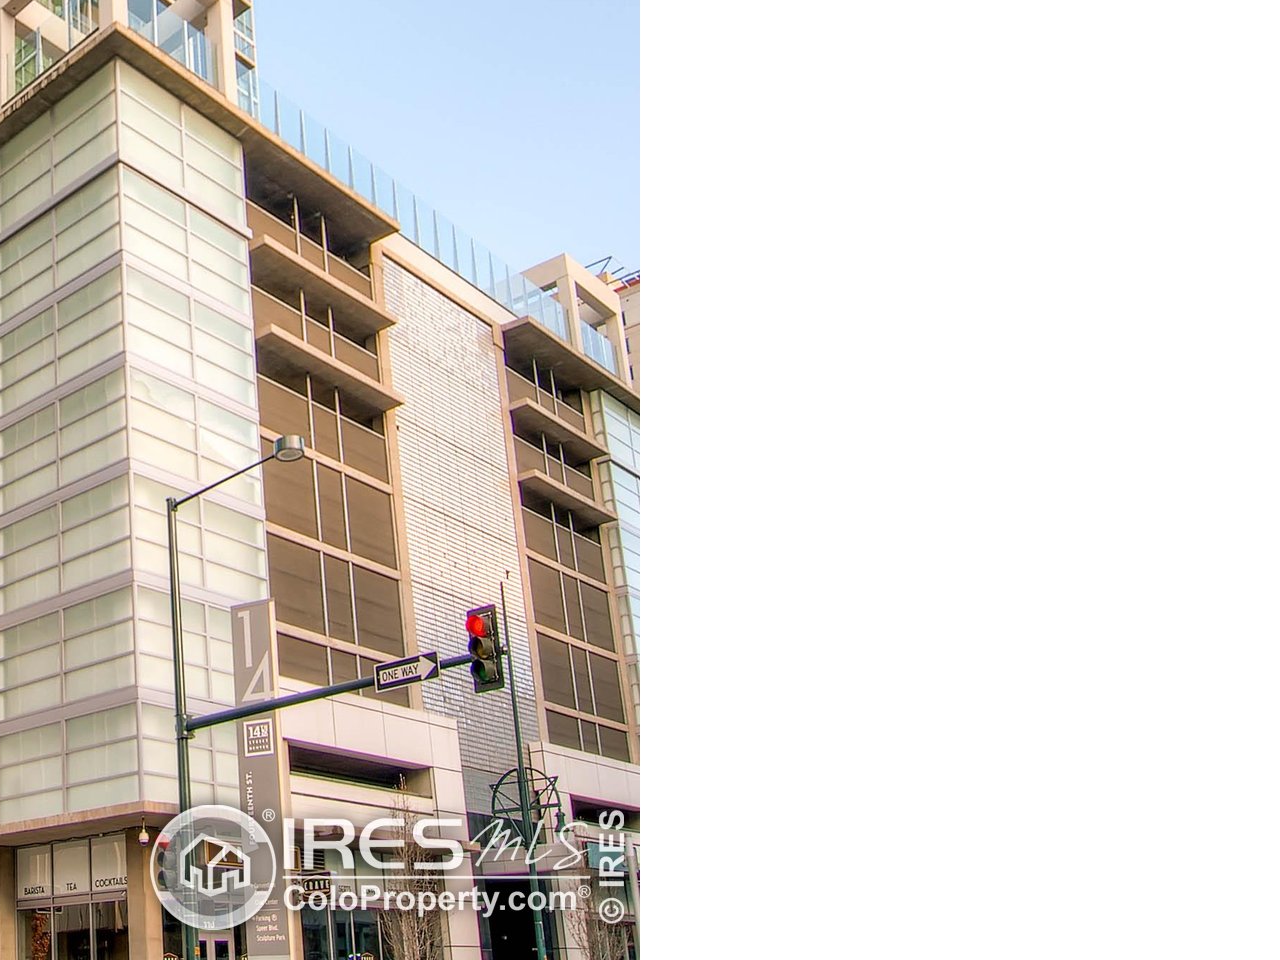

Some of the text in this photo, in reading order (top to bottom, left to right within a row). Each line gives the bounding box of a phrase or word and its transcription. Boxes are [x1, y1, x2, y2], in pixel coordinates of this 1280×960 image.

[381, 664, 419, 682] ONE WAY
[245, 771, 253, 785] ST.
[66, 883, 78, 891] TEA
[94, 876, 128, 888] COCKTAILS
[24, 886, 45, 896] BARISTA
